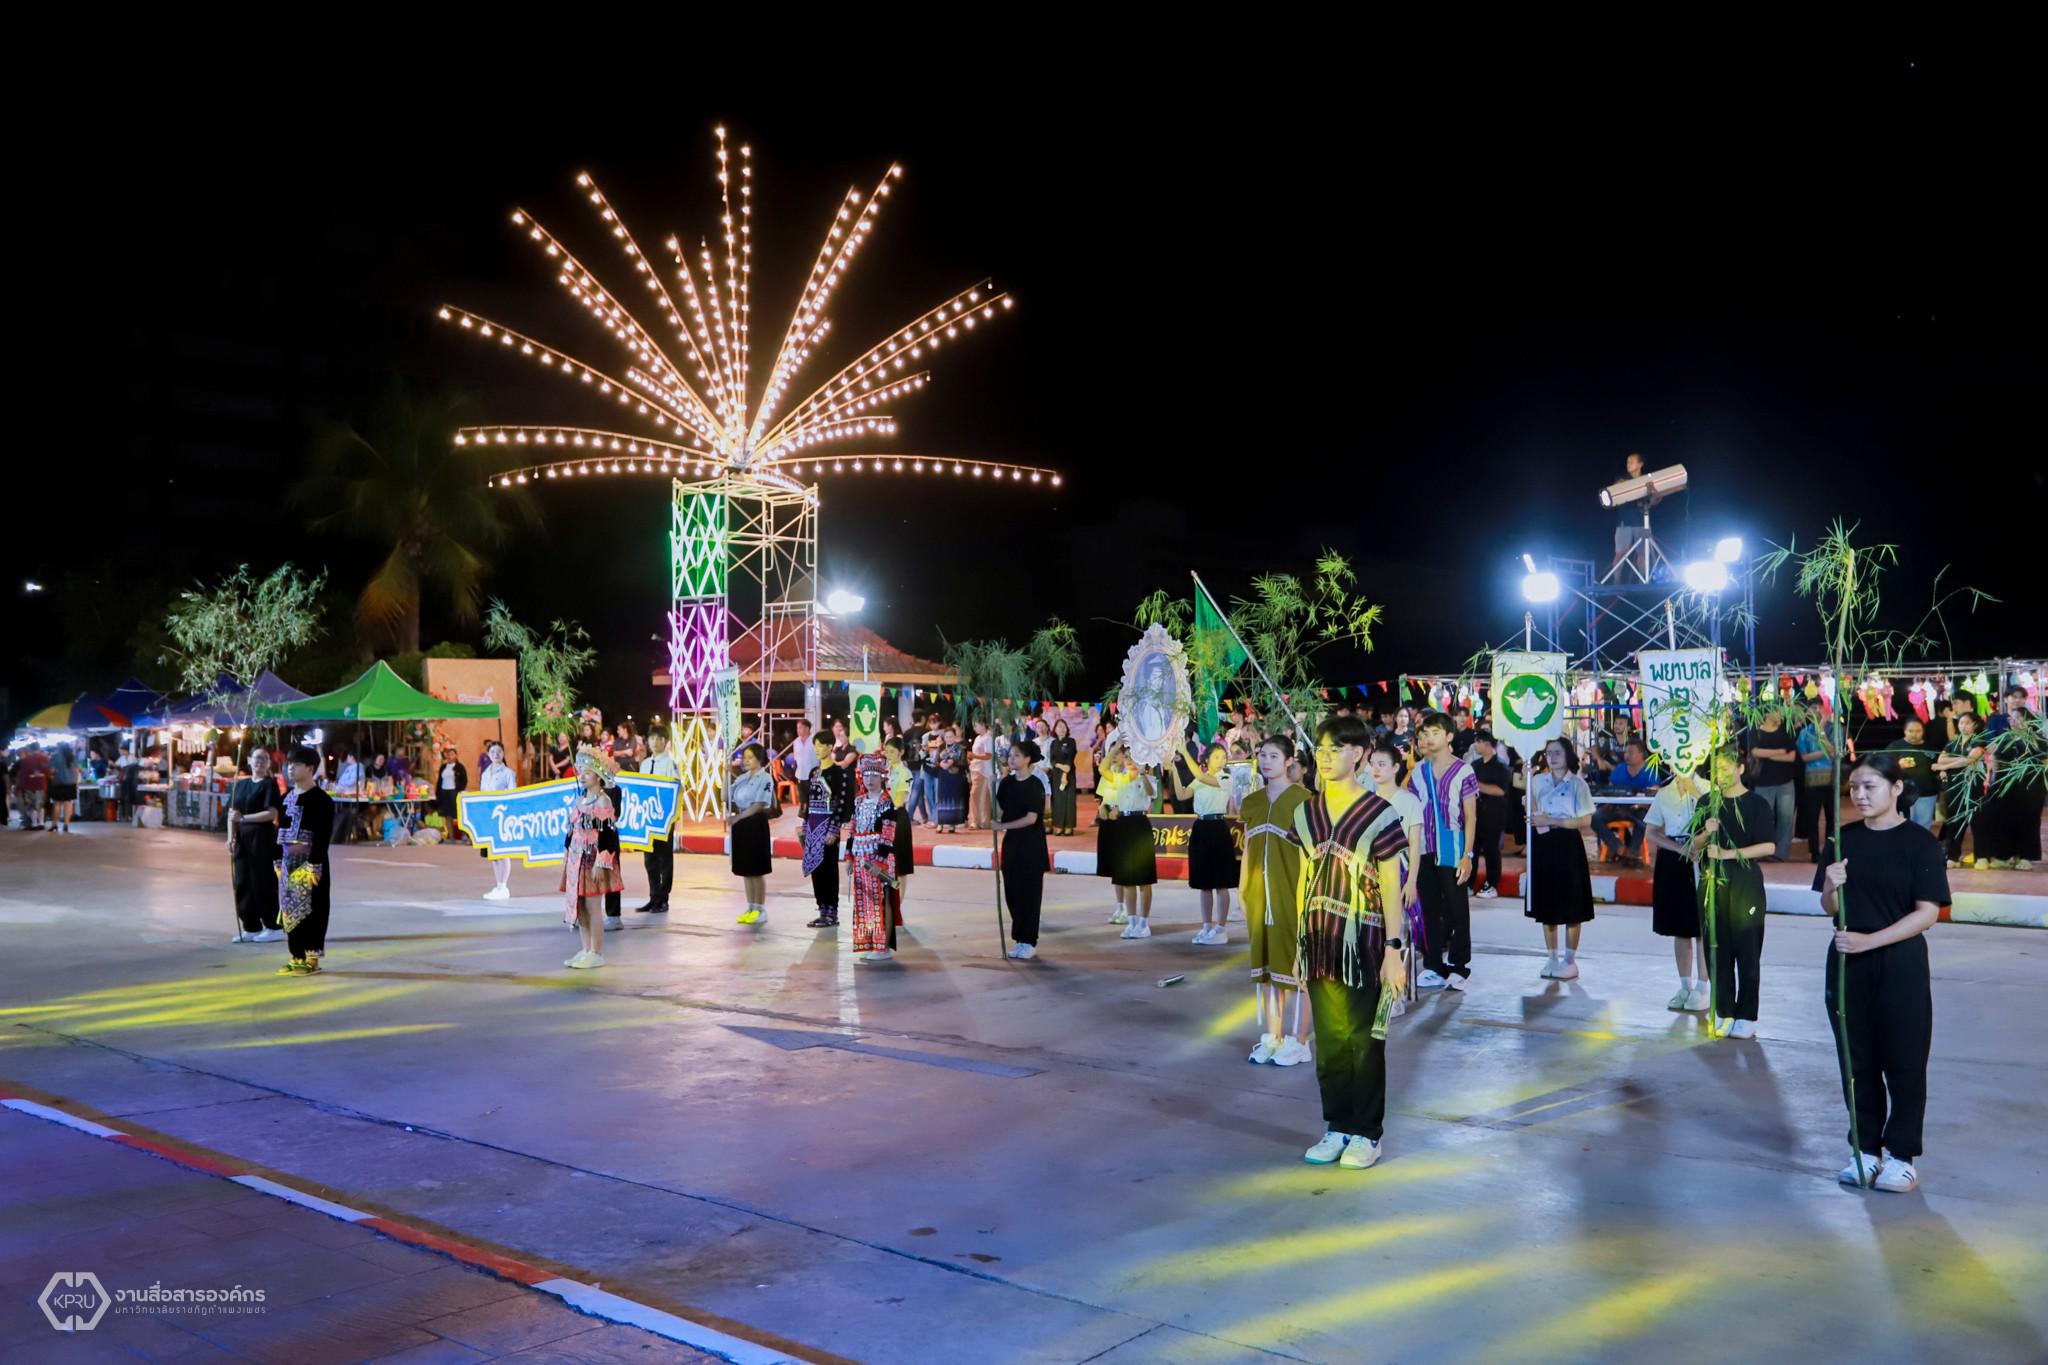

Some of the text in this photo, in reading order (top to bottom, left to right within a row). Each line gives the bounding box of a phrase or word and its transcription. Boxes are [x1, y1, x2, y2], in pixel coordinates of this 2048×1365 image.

[1649, 661, 1711, 681] พยาบาล
[716, 679, 736, 698] NURSE
